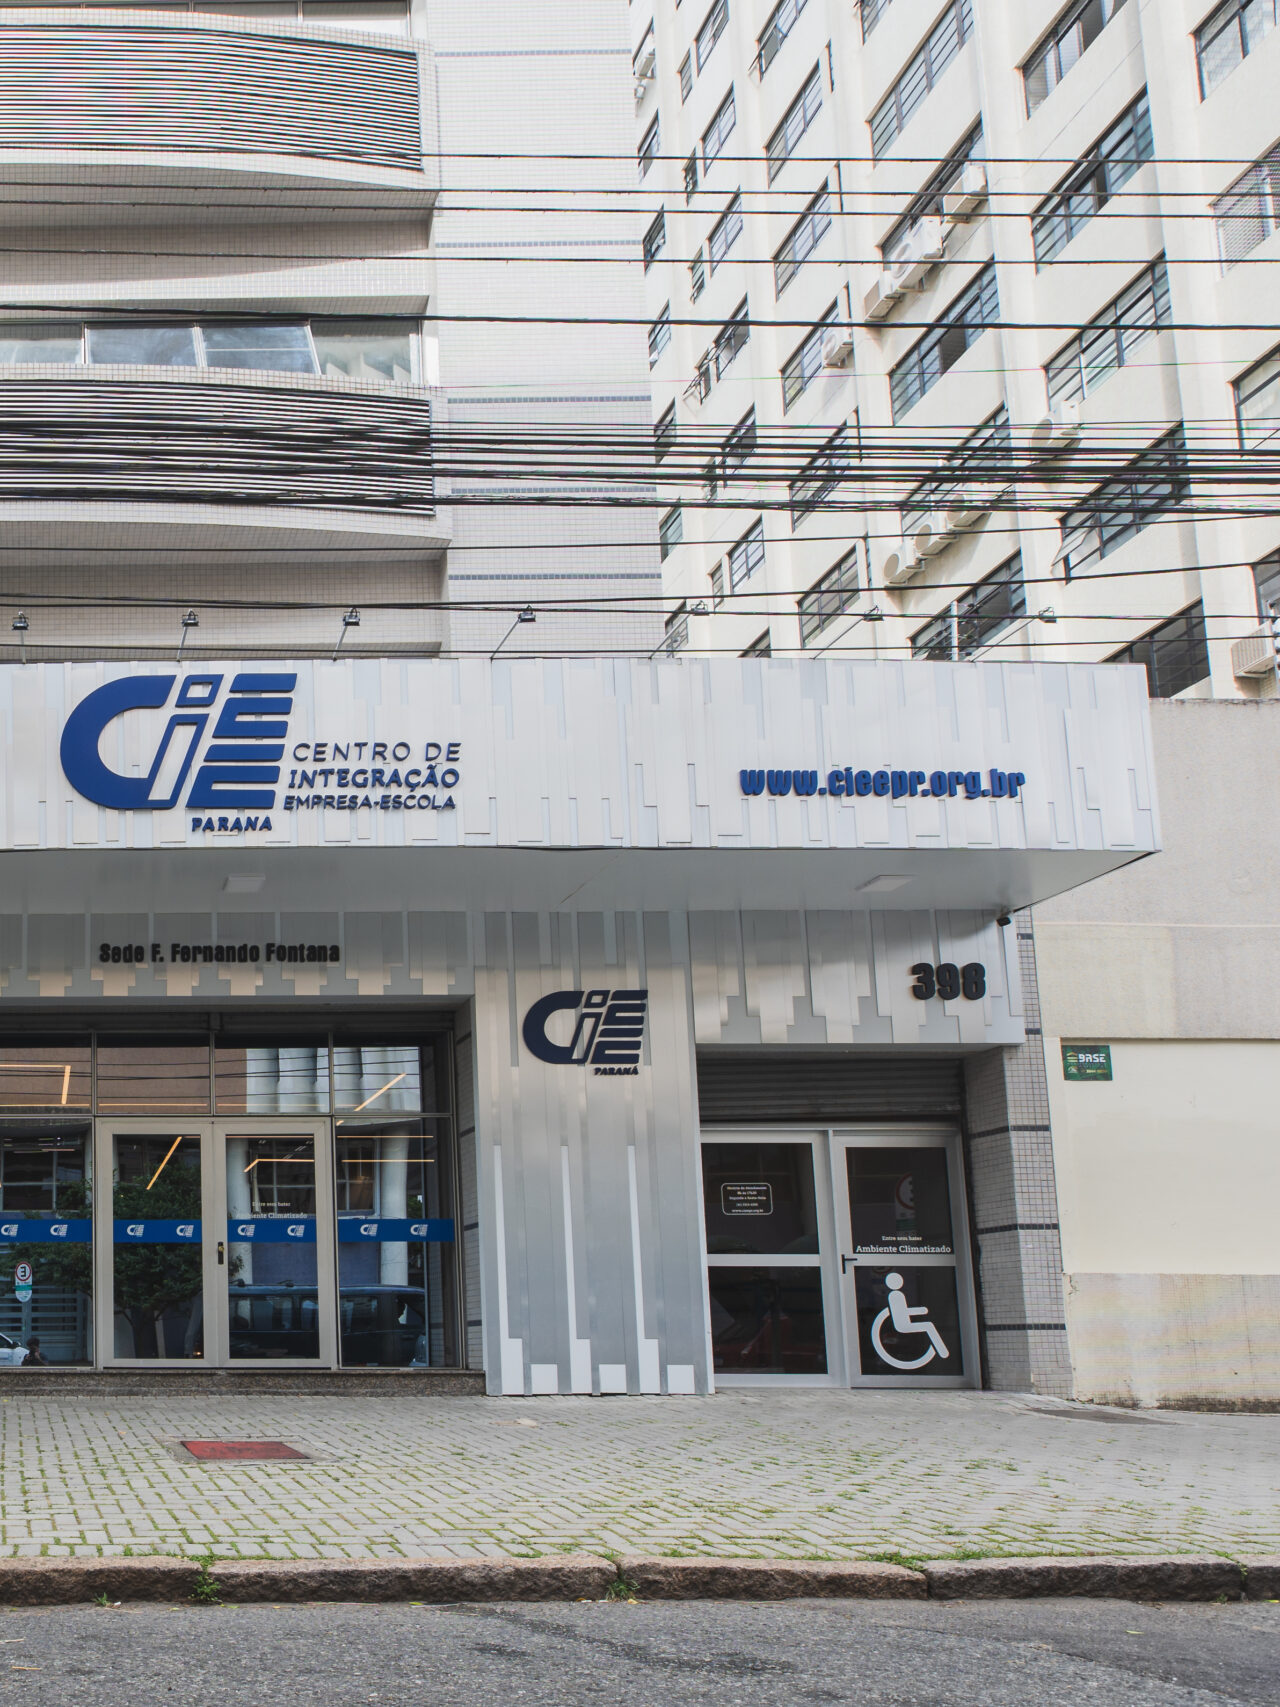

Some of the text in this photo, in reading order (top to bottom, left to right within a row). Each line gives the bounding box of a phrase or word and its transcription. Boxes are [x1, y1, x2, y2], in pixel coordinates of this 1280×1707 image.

[293, 742, 462, 762] CENTRO DE
[288, 764, 460, 792] INTEGRAÇÃO
[739, 767, 1026, 799] www.cieepr.org.br
[283, 794, 456, 810] EMPRESA-ESCOLA
[99, 942, 340, 963] Sede F. Fernando Fontana
[911, 962, 986, 1000] 398
[1078, 1053, 1106, 1063] BASE
[856, 1245, 951, 1253] Ambiente Climatizado
